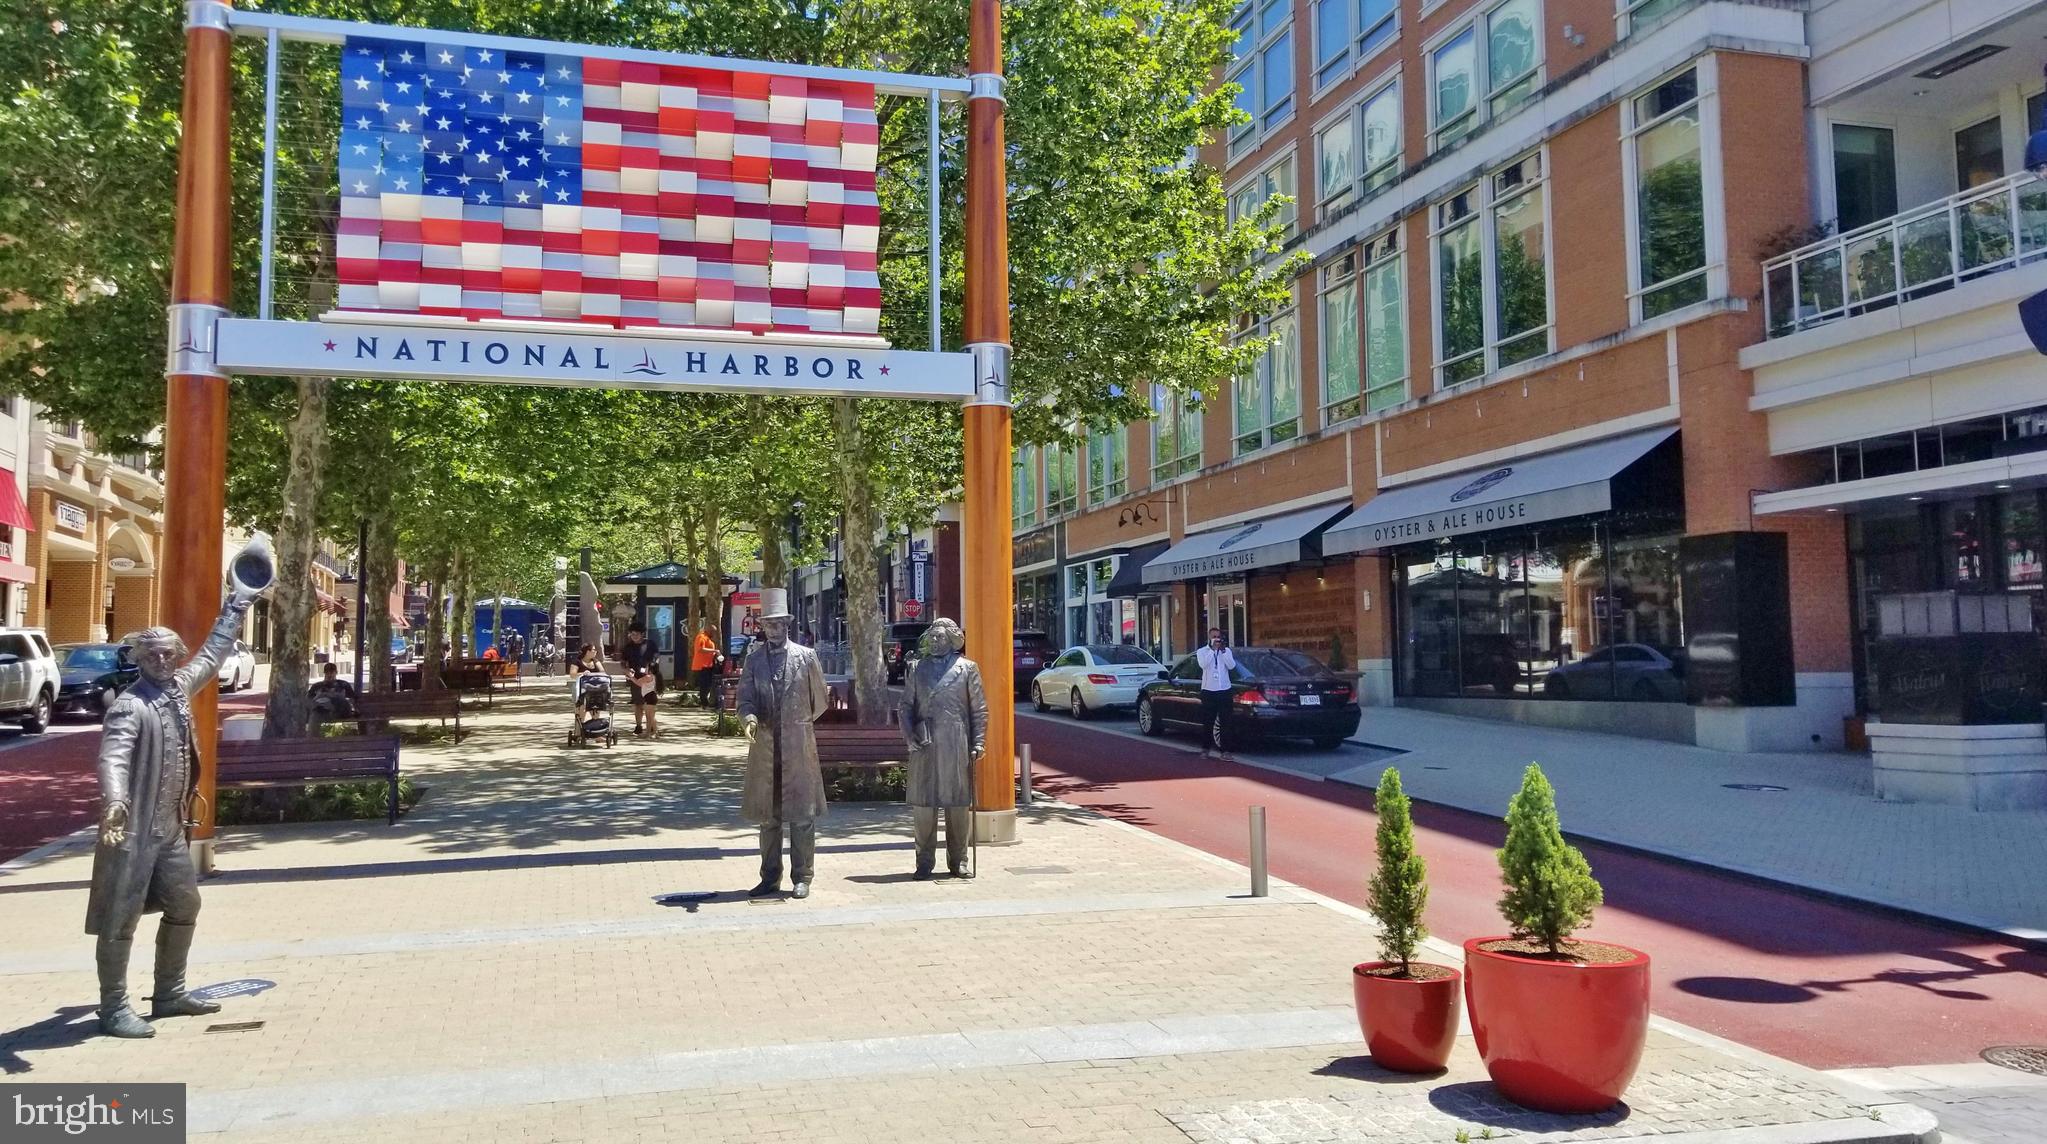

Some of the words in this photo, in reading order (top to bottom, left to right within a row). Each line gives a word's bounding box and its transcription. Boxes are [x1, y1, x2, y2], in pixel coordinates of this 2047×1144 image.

[355, 336, 610, 369] NATIONAL
[686, 351, 864, 379] HARBOR
[1374, 522, 1421, 541] OYSTER
[1428, 520, 1435, 533] &
[1443, 513, 1467, 530] ALE
[1476, 503, 1525, 524] HOUSE
[1173, 564, 1203, 576] OYSTER
[1210, 558, 1224, 570] ALE
[1228, 553, 1255, 567] HOUSE
[905, 605, 920, 613] STOP
